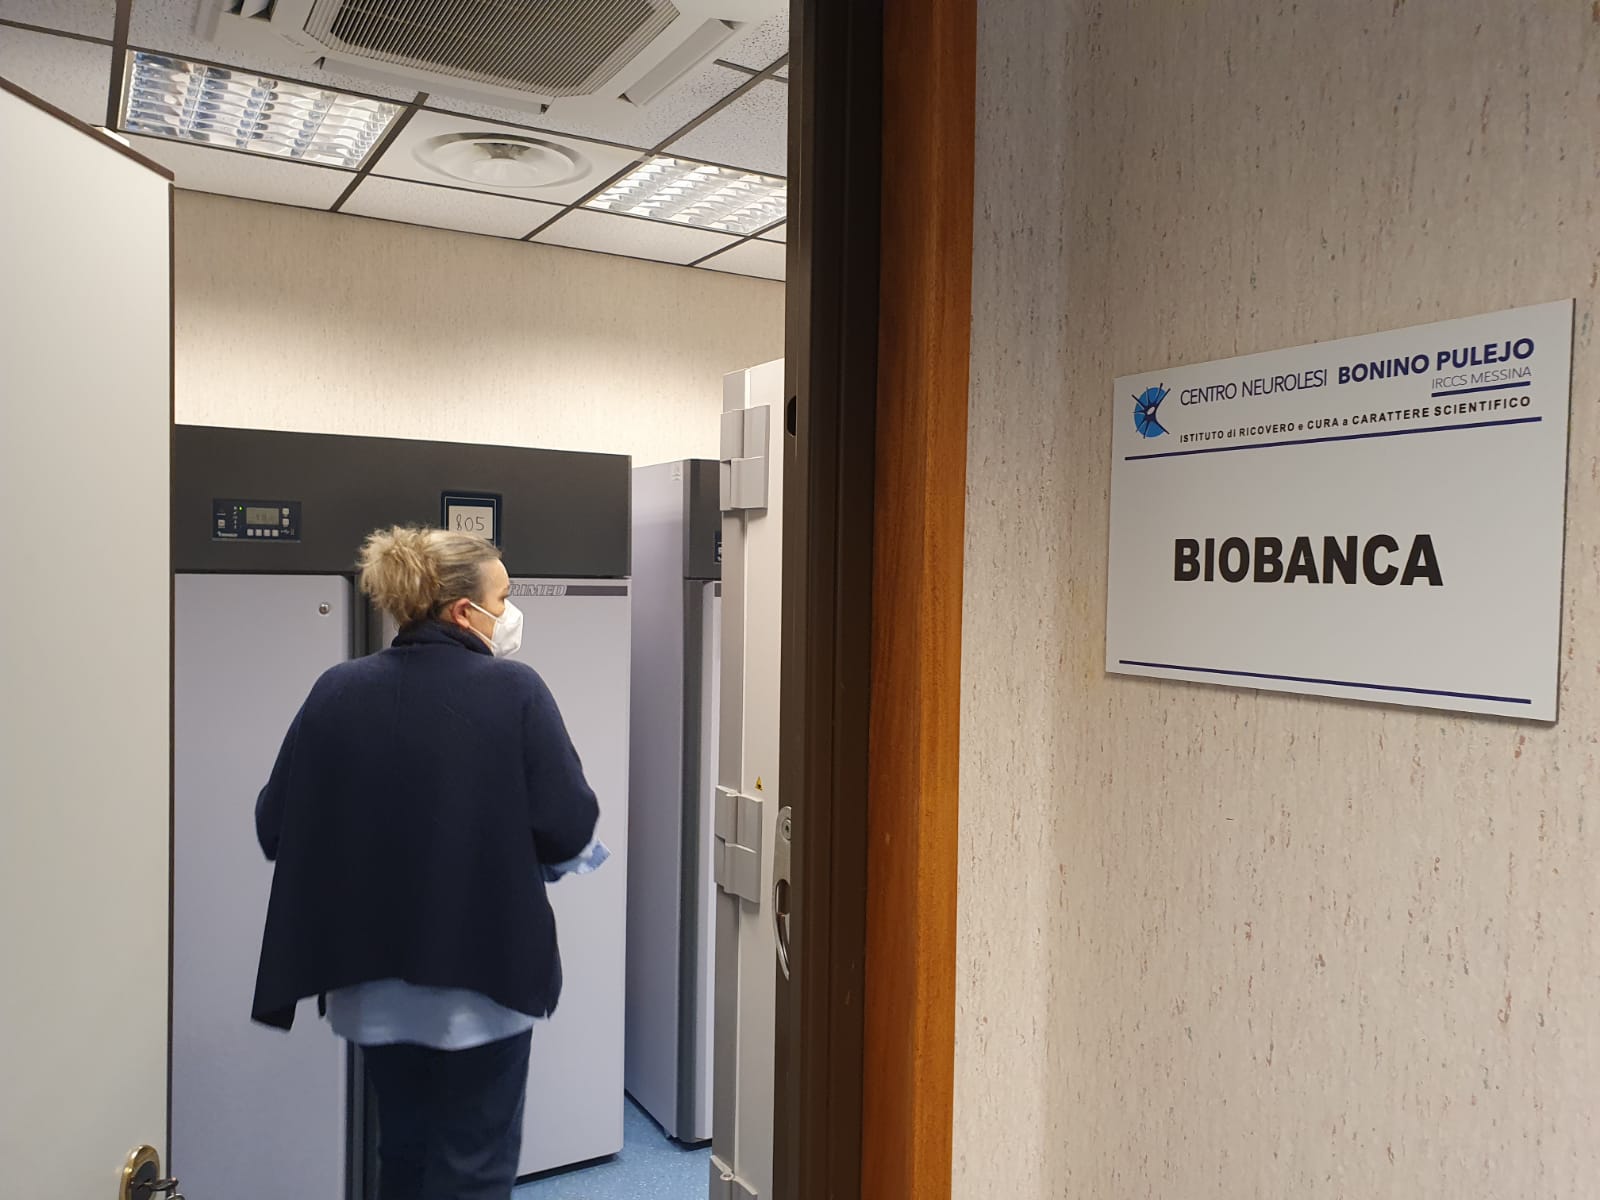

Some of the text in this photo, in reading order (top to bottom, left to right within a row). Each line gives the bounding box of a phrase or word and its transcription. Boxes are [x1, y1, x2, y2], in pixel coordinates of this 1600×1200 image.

[1180, 338, 1535, 406] CENTRO NEUROLESI BONINO PULEJO
[1432, 366, 1532, 389] IRCCS MESSINA
[1180, 396, 1531, 443] ISTITUTO di RICOVERO e CURA a CARATTERE SCIENTIFICO
[456, 513, 485, 532] 805
[1174, 534, 1444, 586] BIOBANCA
[508, 583, 568, 597] RIMED
